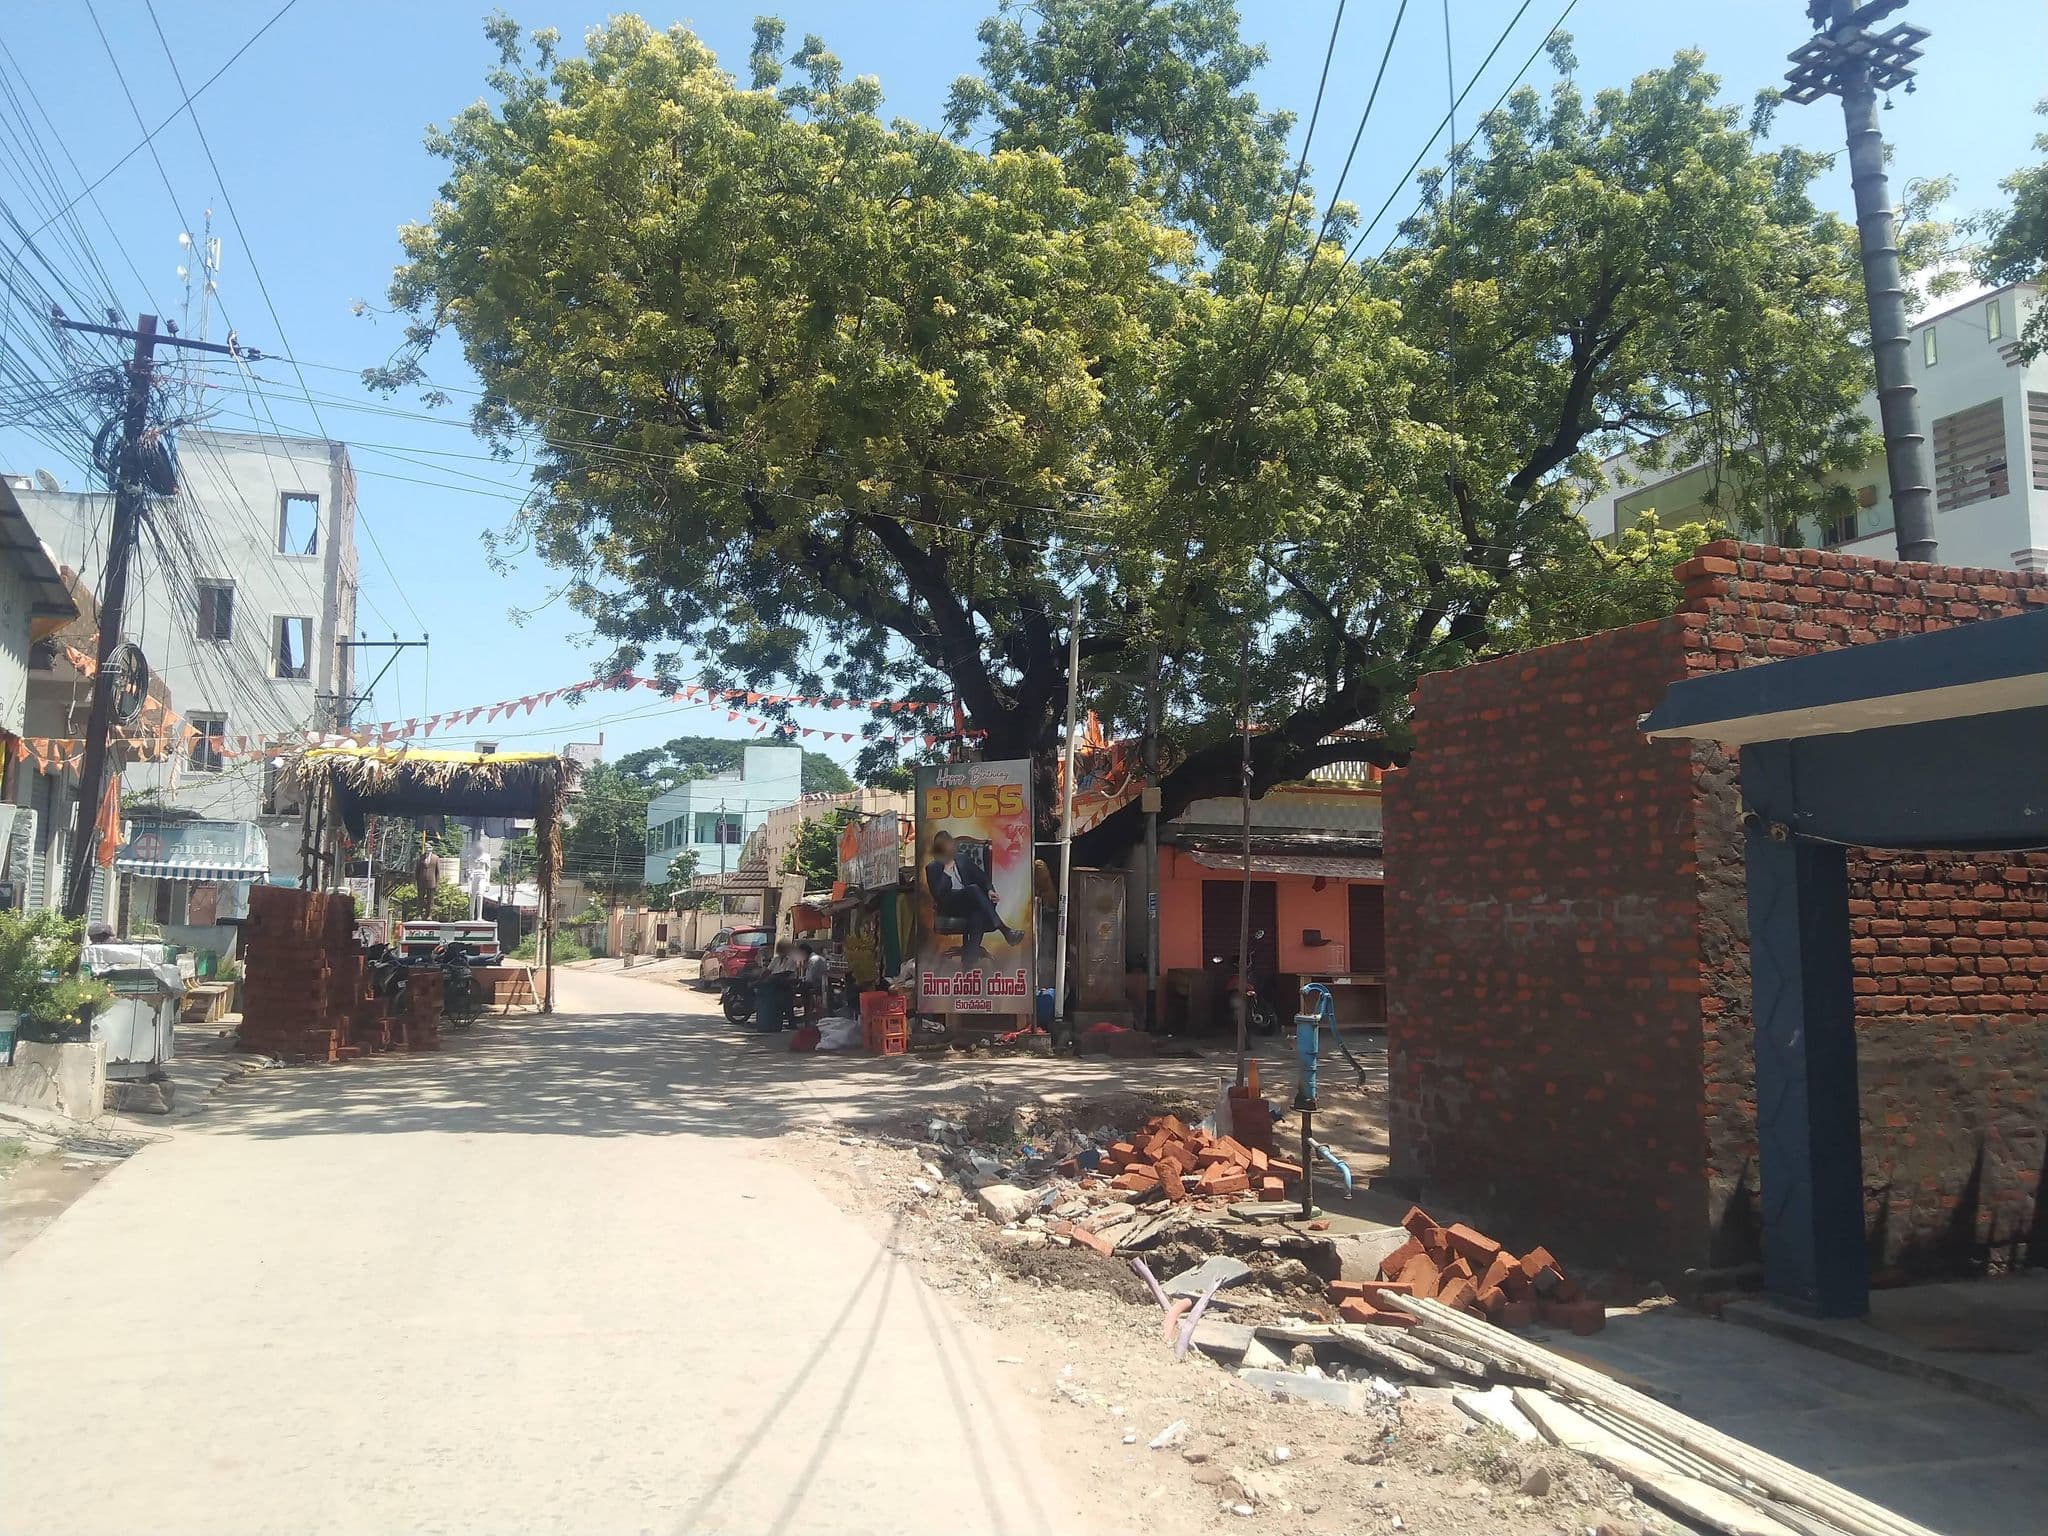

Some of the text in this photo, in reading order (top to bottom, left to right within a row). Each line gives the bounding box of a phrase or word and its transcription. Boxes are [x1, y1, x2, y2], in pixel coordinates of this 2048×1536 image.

[936, 766, 1009, 787] Happy Birthday
[925, 784, 1025, 819] BOSS
[922, 967, 1027, 996] మెగా పవర్ యూత్
